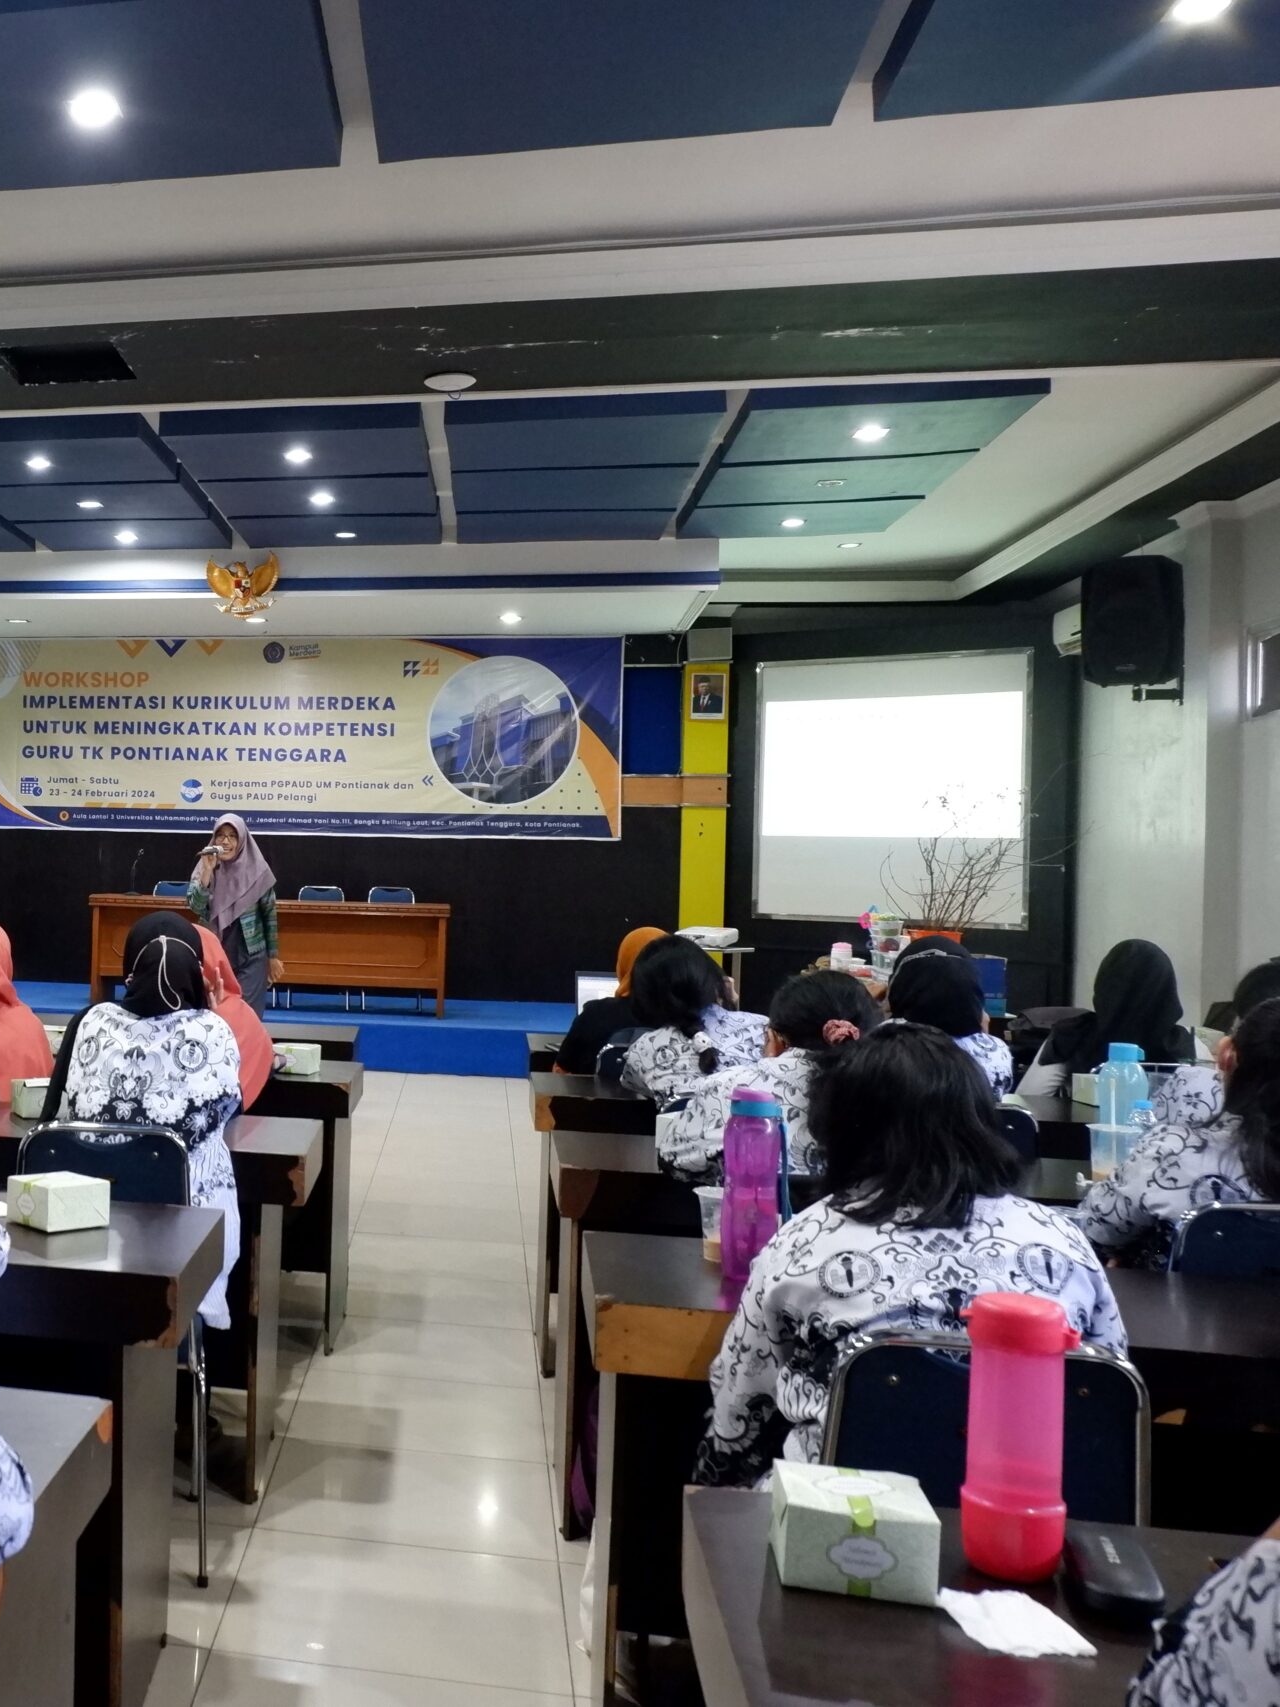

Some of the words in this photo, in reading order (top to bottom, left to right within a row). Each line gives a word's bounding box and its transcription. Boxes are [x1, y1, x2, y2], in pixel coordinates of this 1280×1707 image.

[23, 672, 150, 688] WORKSHOP
[23, 695, 166, 710] IMPLEMENTASI
[173, 696, 290, 710] KURIKULUM
[297, 696, 396, 711] MERDEKA
[23, 720, 87, 735] UNTUK
[94, 721, 257, 736] MENINGKATKAN
[264, 722, 395, 737] KOMPETENSI
[22, 745, 73, 760] GURU
[80, 746, 103, 760] TK
[111, 746, 229, 762] PONTIANAK
[236, 747, 347, 763] TENGGARA
[47, 776, 78, 785] Jumat
[90, 776, 119, 785] Sabtu
[210, 779, 268, 790] Kerjasama
[271, 780, 312, 789] PGPAUD
[316, 781, 332, 789] UM
[335, 781, 391, 790] Pontianak
[393, 781, 414, 790] dan
[49, 789, 60, 797] 23
[71, 789, 82, 797] 24
[85, 789, 128, 798] Februari
[131, 790, 155, 798] 2024
[210, 792, 244, 803] Gugus
[246, 793, 274, 801] PAUD
[277, 793, 317, 803] Pelangi
